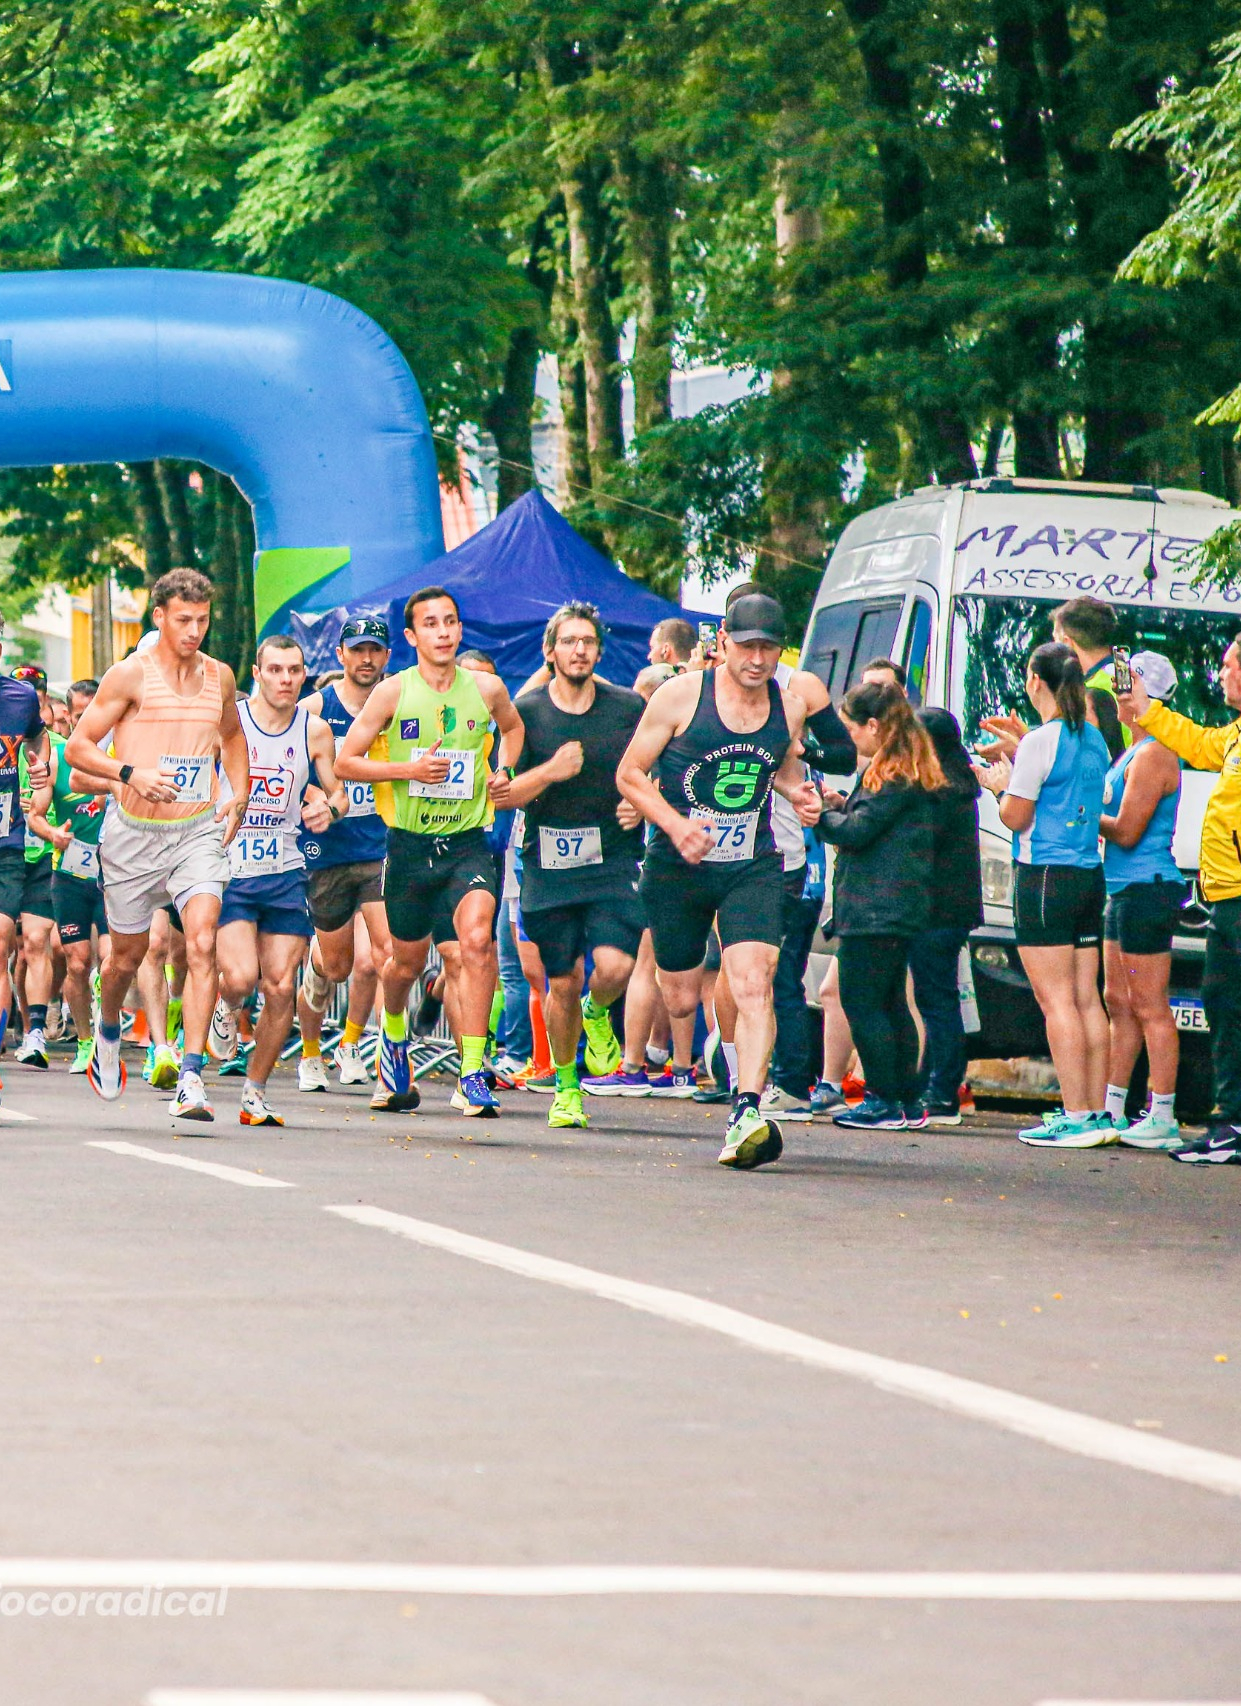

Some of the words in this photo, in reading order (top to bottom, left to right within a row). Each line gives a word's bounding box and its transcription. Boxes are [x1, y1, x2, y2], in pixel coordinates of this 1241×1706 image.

[954, 524, 1207, 563] MARTE
[963, 568, 1156, 601] ASSESSORIA
[704, 743, 755, 763] PROTEIN
[756, 747, 777, 766] BOX
[174, 766, 200, 788] 67
[444, 760, 465, 784] 2
[249, 796, 281, 806] ARCISO
[237, 837, 279, 862] 154
[555, 836, 583, 857] 97
[1174, 1009, 1209, 1028] 5E
